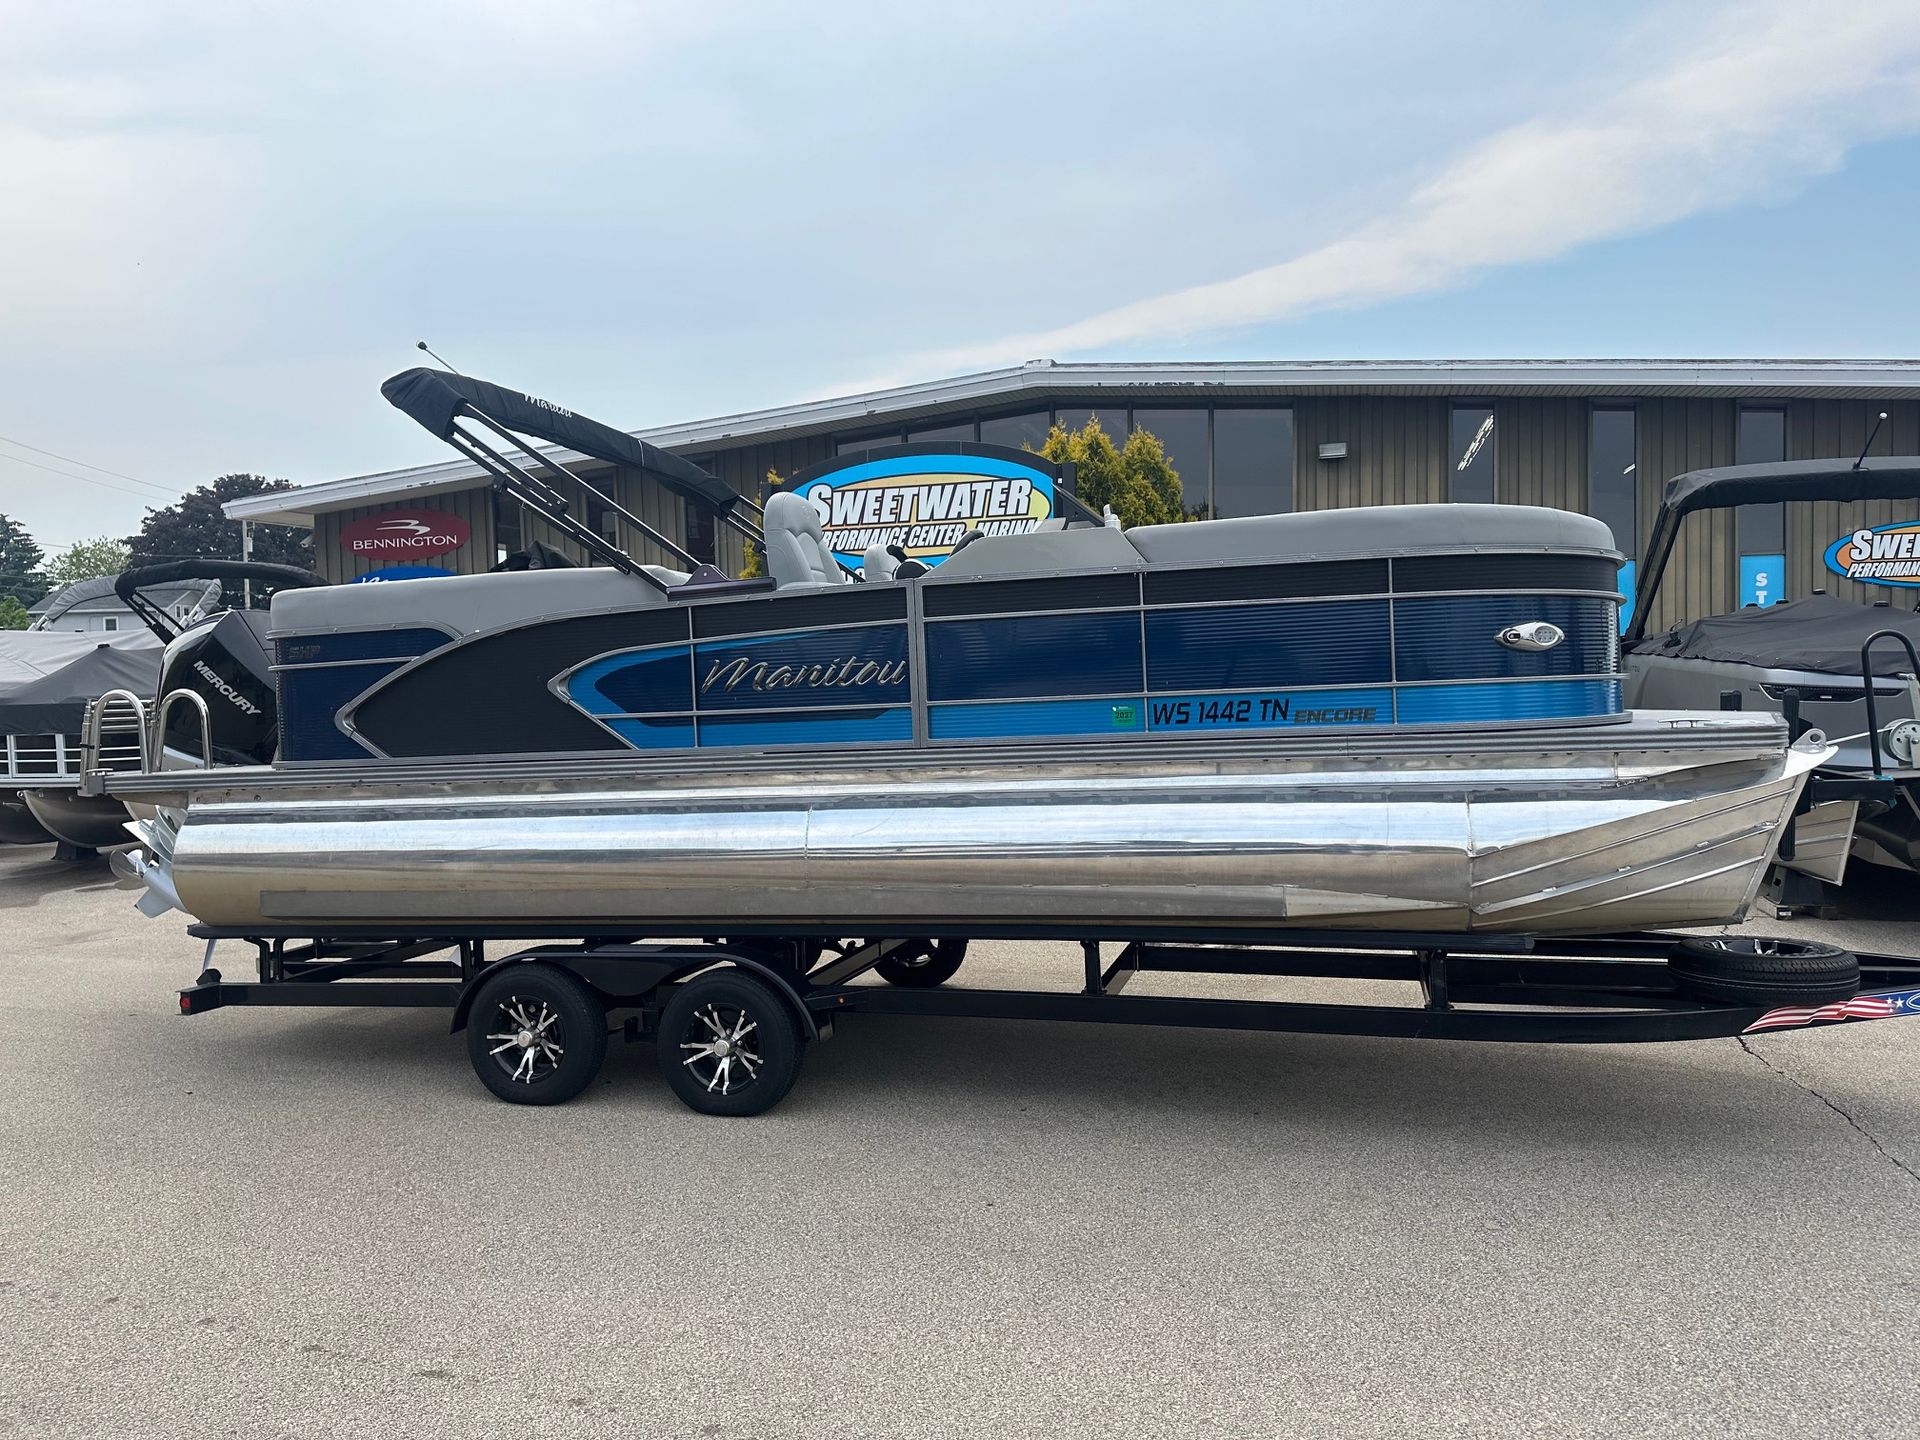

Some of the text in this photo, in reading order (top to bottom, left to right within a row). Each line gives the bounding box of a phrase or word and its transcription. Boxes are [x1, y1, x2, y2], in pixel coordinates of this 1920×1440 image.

[808, 479, 1032, 526] SWEETWATER
[353, 535, 457, 550] BENNINGTON
[821, 526, 908, 550] RFORMANCE
[909, 523, 965, 547] CENTER
[193, 660, 262, 715] MERCURY
[701, 655, 906, 694] Manitou
[1115, 711, 1133, 719] 2027
[1153, 698, 1290, 725] WS 1442 TN
[1294, 707, 1377, 723] ENCORE
